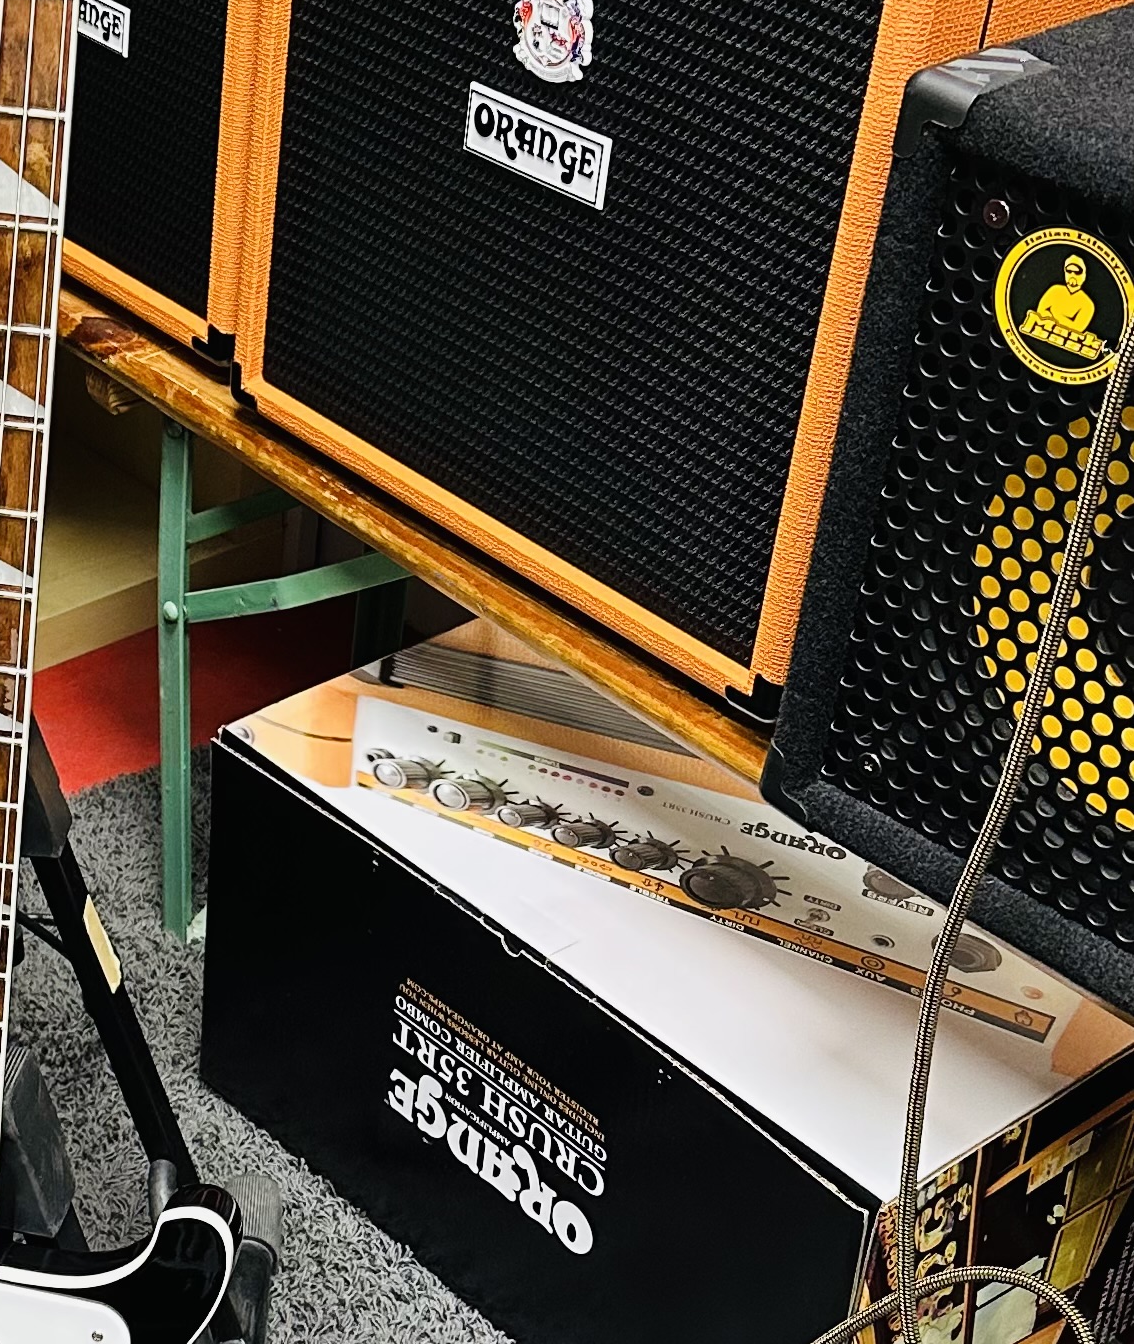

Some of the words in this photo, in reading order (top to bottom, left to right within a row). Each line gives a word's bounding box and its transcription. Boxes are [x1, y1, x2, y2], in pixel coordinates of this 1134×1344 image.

[474, 102, 597, 185] ORANGE
[1024, 231, 1071, 247] Italian
[689, 808, 731, 825] CRUSH
[739, 822, 847, 861] ORANGE
[709, 914, 745, 932] DIRTY
[777, 937, 834, 965] CHANNEL
[854, 966, 886, 983] AUX
[399, 983, 418, 1002] YOU
[910, 986, 976, 1017] PHOS
[395, 995, 452, 1044] COMBO
[406, 977, 491, 1044] ORANGEAMPS.COM
[418, 997, 446, 1023] WHEN
[446, 1017, 485, 1051] LESSONS
[491, 1040, 504, 1052] AT
[392, 1018, 473, 1097] 35RT
[454, 1036, 541, 1109] AMPLIFIER
[486, 1046, 521, 1077] GUITAR
[504, 1051, 526, 1069] AMP
[521, 1073, 558, 1105] ONLINE
[526, 1065, 552, 1092] YOUR
[444, 1092, 511, 1147] AMPLIFICATION
[553, 1085, 600, 1127] REGISTER
[558, 1101, 605, 1143] INCLUDES
[479, 1081, 605, 1197] CRUSH
[542, 1103, 608, 1162] GUITAR
[388, 1068, 594, 1255] ORANGE
